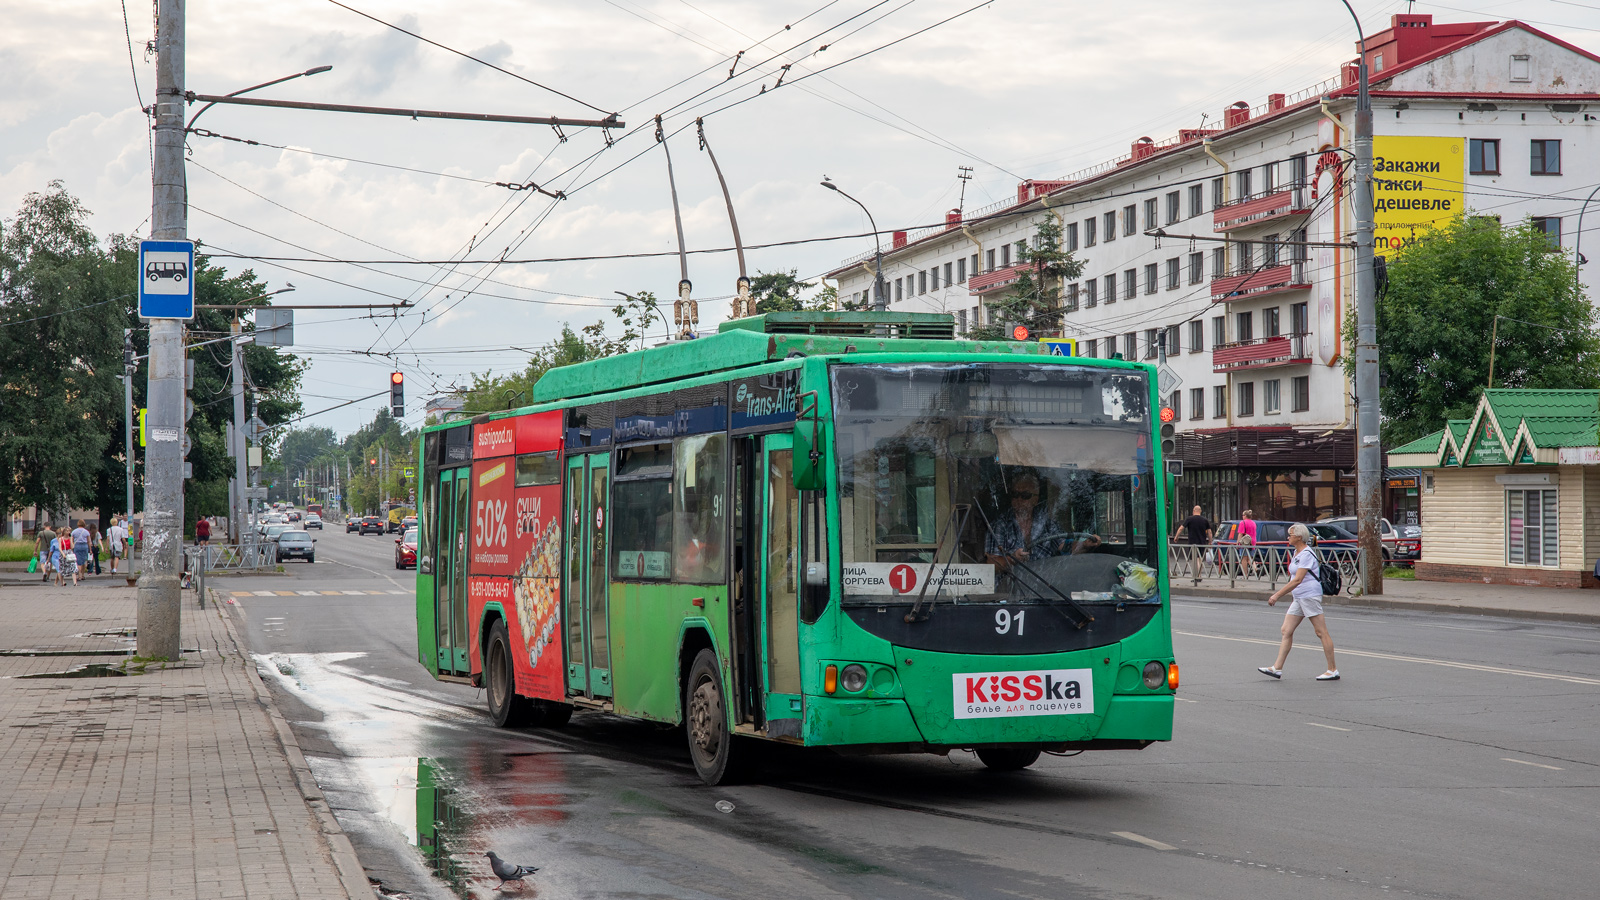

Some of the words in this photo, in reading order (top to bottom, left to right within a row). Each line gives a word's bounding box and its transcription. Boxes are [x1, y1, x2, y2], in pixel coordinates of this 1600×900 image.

[1375, 157, 1440, 173] Закажи
[1377, 180, 1423, 191] такси
[1380, 222, 1433, 230] приложении
[746, 387, 796, 418] Trans-Alfa
[478, 426, 513, 450] sushigood.ru
[516, 497, 541, 519] СУШИ
[713, 493, 723, 518] 91
[475, 499, 508, 548] 50%
[480, 551, 494, 567] наборы
[494, 553, 509, 567] роллов
[843, 567, 867, 576] ЛИЦА
[896, 567, 907, 591] 1
[994, 608, 1026, 636] 91
[967, 705, 1001, 714] белье
[1006, 704, 1025, 713] для
[1029, 703, 1082, 712] поцелуев
